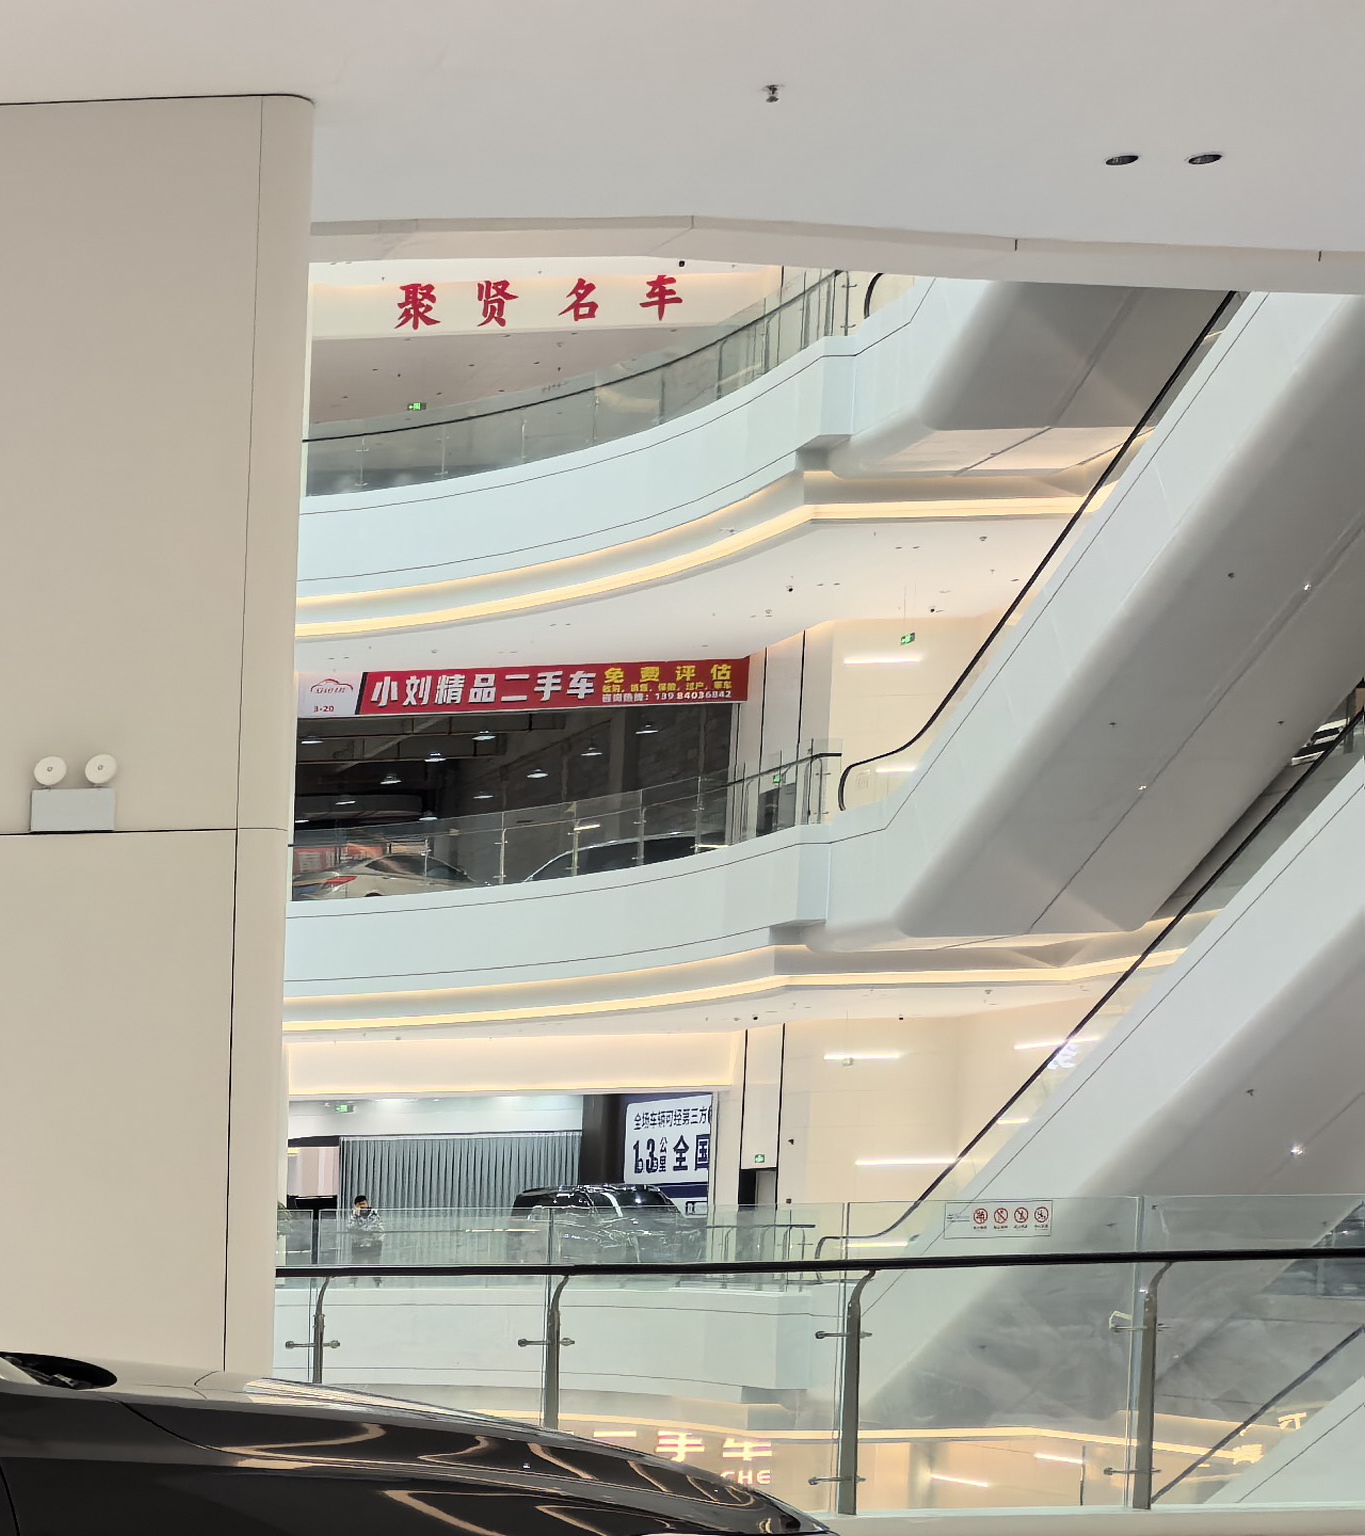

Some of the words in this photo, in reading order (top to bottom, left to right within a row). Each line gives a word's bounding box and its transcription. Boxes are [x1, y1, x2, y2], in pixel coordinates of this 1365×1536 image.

[394, 275, 683, 330] 聚贤名车
[371, 670, 596, 706] 小刘精品二手车
[604, 664, 732, 684] 免费评估
[634, 1106, 711, 1130] 全场车辆可经第三方
